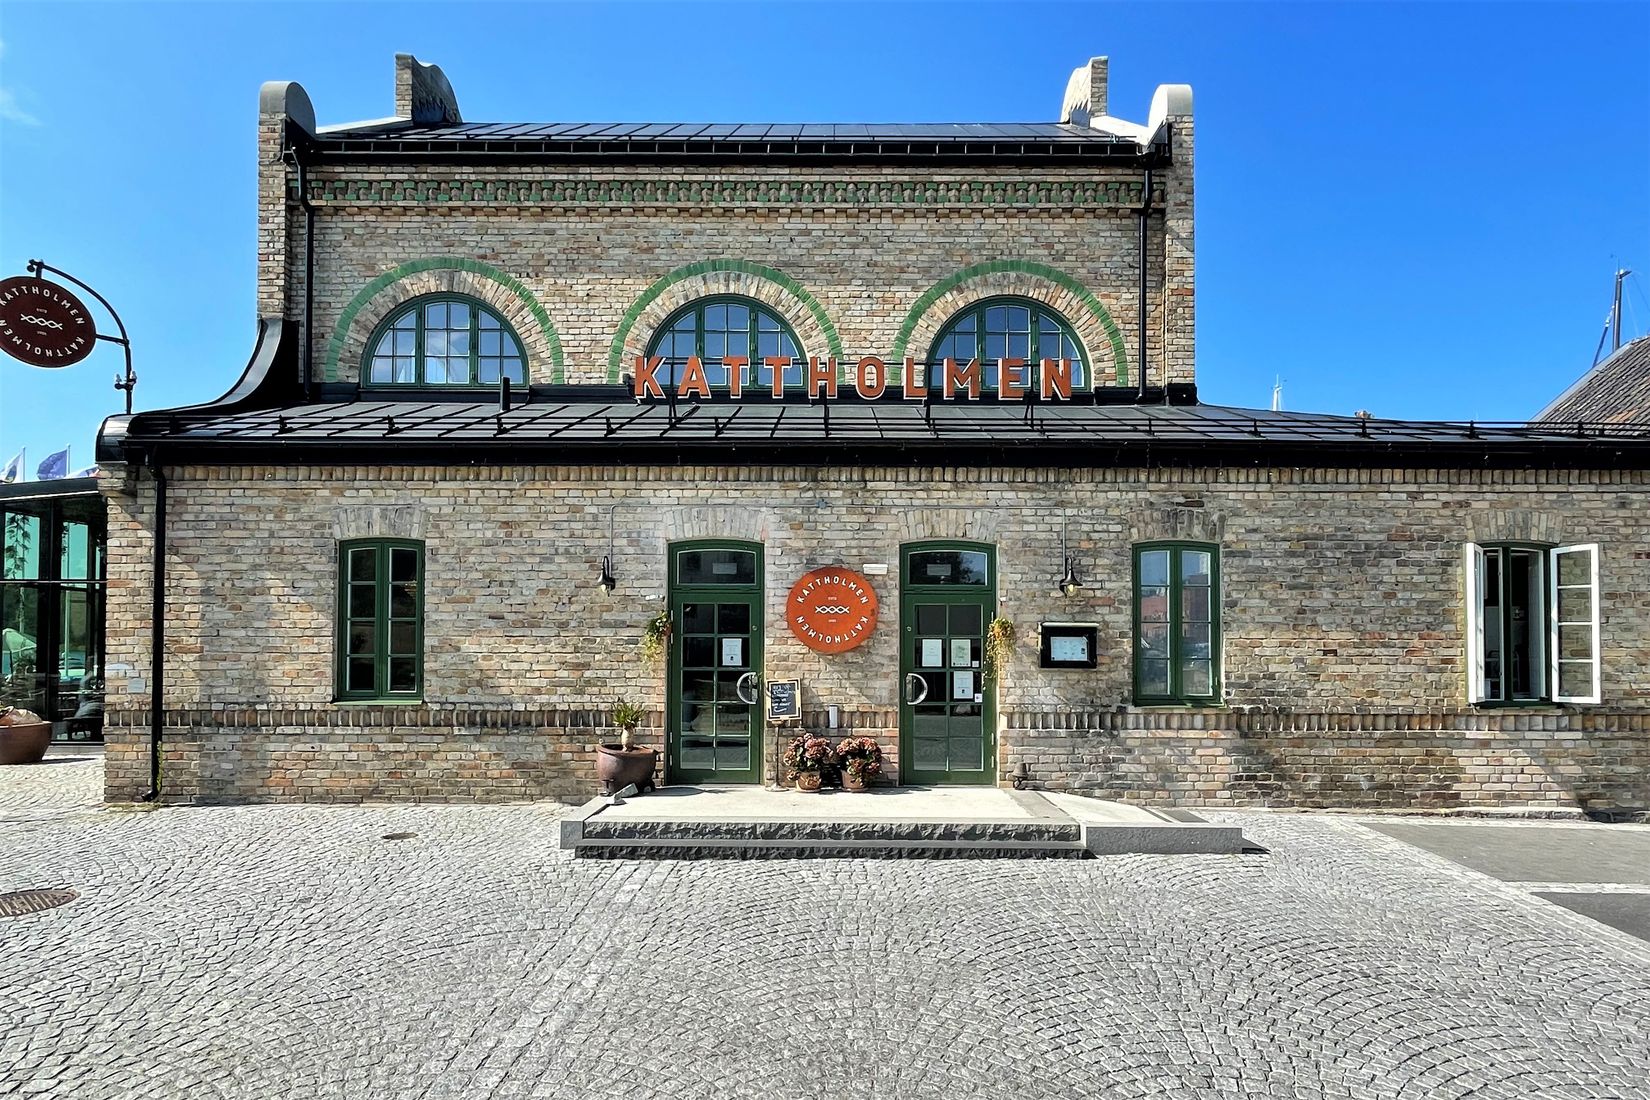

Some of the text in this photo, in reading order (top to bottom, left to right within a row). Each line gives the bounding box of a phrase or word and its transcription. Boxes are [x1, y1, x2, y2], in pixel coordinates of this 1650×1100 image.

[0, 286, 85, 324] KATTHOLMEN
[0, 319, 85, 357] KATTHOLMEN
[634, 356, 1072, 400] KATTHOLMEN
[796, 576, 869, 604] KATTHOLMEN
[796, 616, 869, 643] KATTHOLMEN
